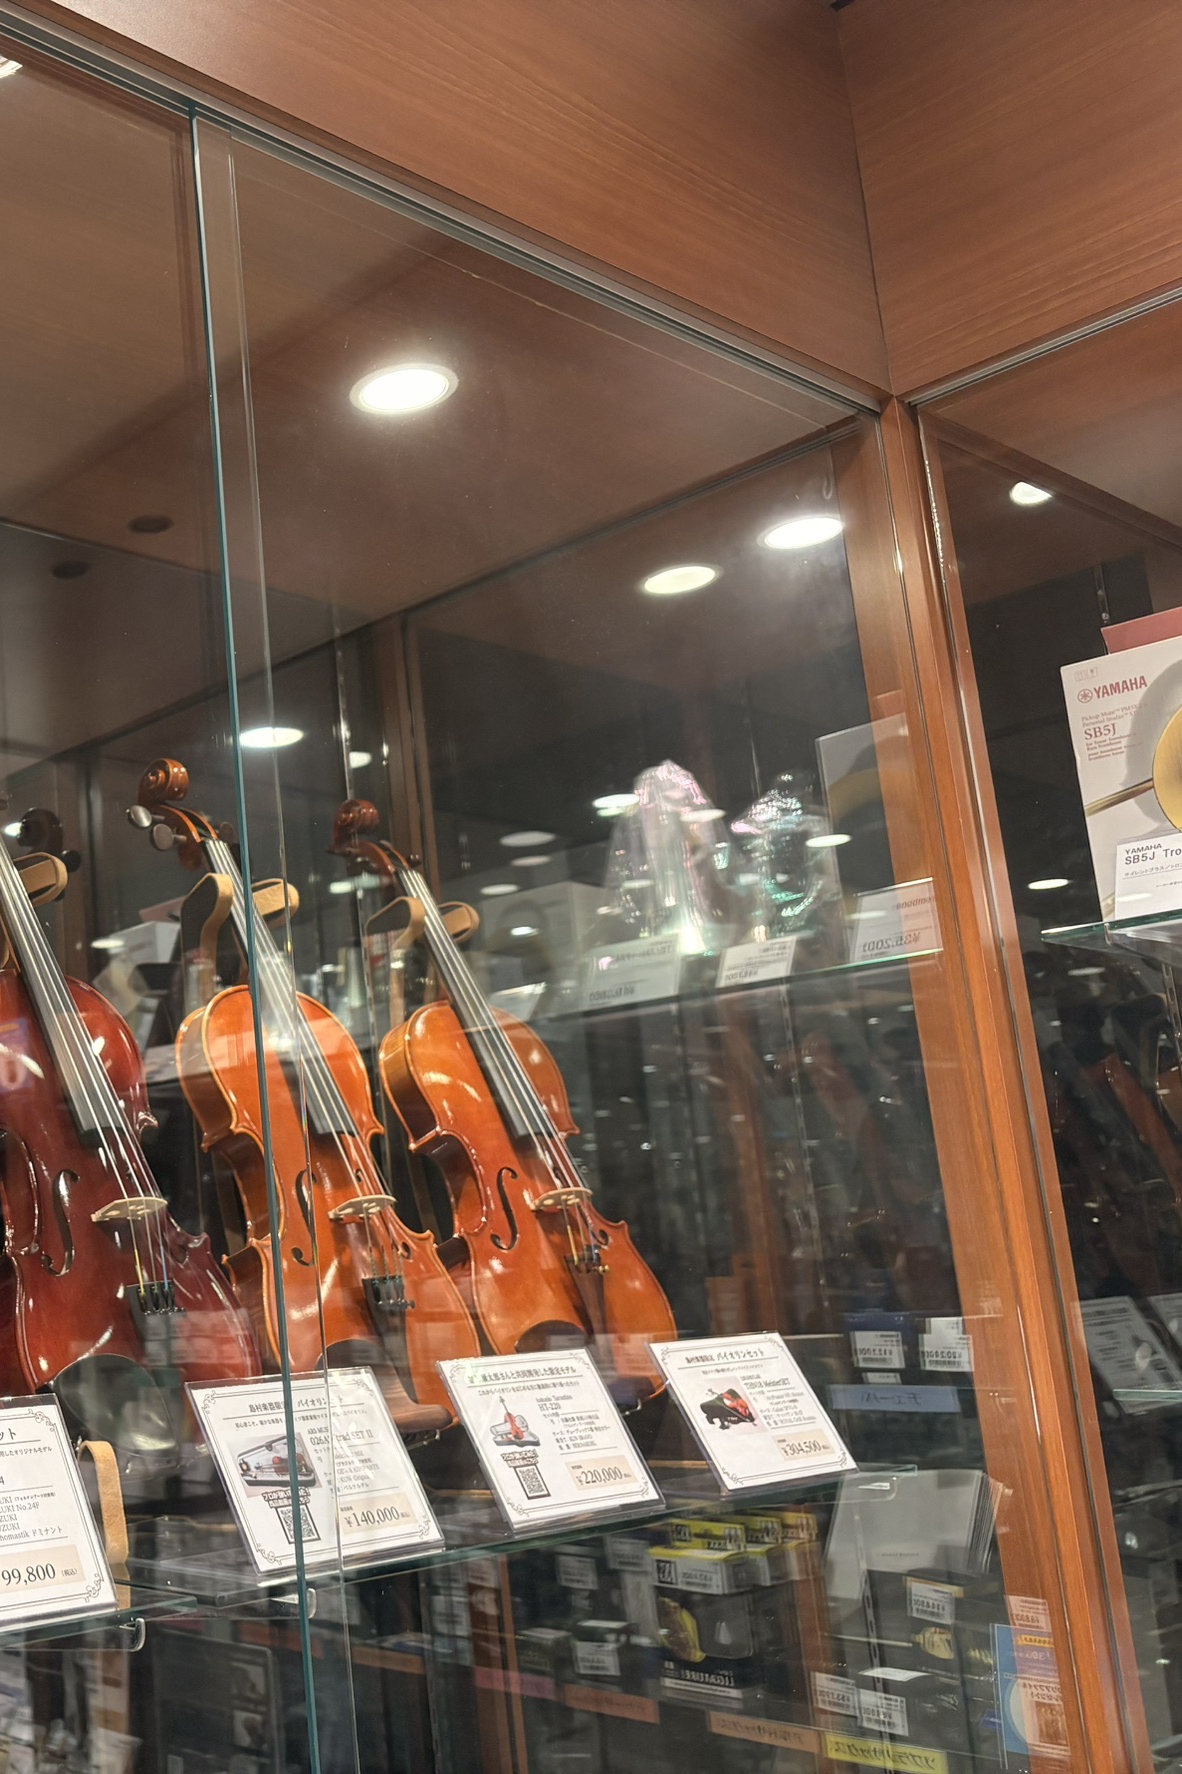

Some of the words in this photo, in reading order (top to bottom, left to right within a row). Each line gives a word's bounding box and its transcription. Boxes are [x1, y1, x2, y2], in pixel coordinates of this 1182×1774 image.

[1093, 675, 1148, 699] YAMAHA
[1084, 722, 1116, 740] SB5J
[1125, 843, 1162, 855] YAMAHA
[1125, 851, 1155, 865] SB5J
[576, 1466, 623, 1485] ¥220,000
[344, 1506, 400, 1528] ¥140,000
